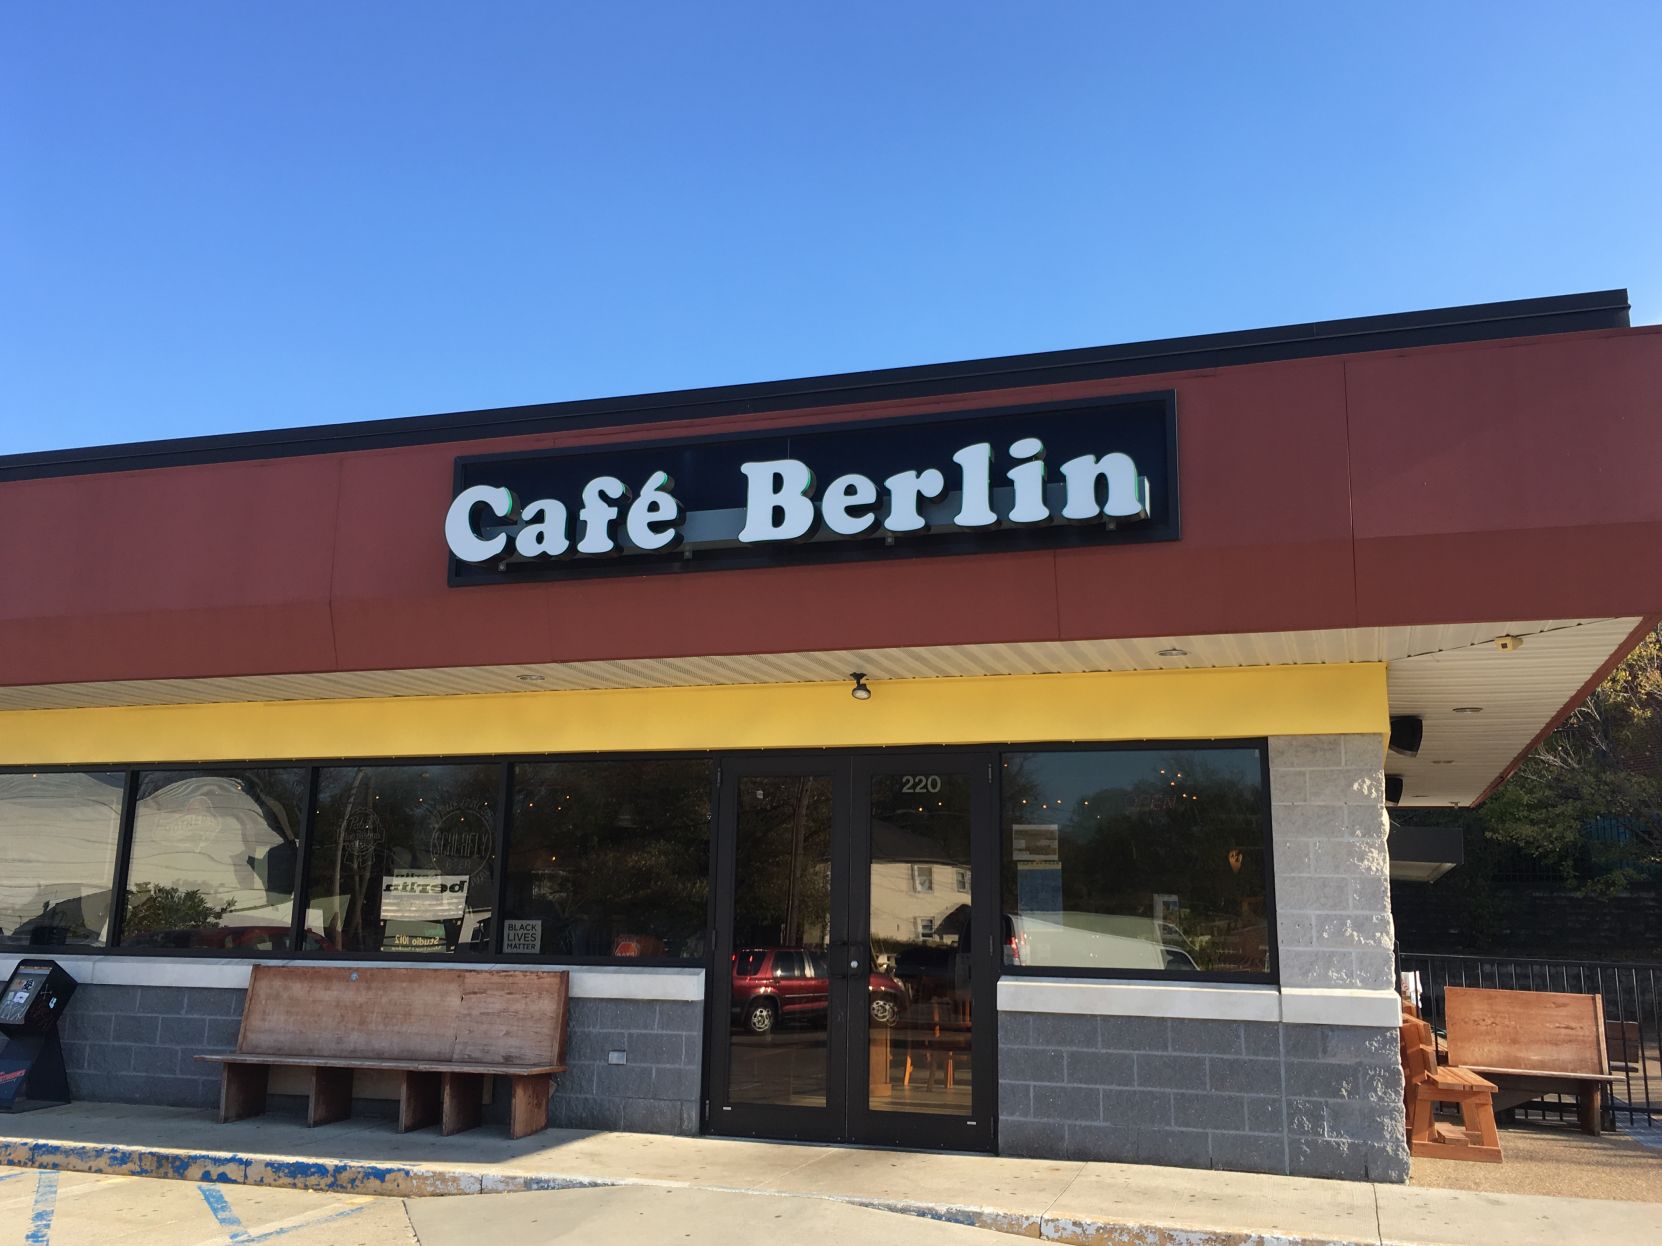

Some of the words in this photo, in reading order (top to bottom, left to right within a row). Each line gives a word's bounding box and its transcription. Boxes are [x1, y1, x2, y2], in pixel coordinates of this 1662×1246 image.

[445, 470, 679, 563] Café
[738, 437, 1146, 544] Berlin
[902, 775, 942, 793] 220
[507, 923, 537, 932] BLACK
[507, 932, 537, 943] LIVES
[506, 942, 537, 951] MATTER
